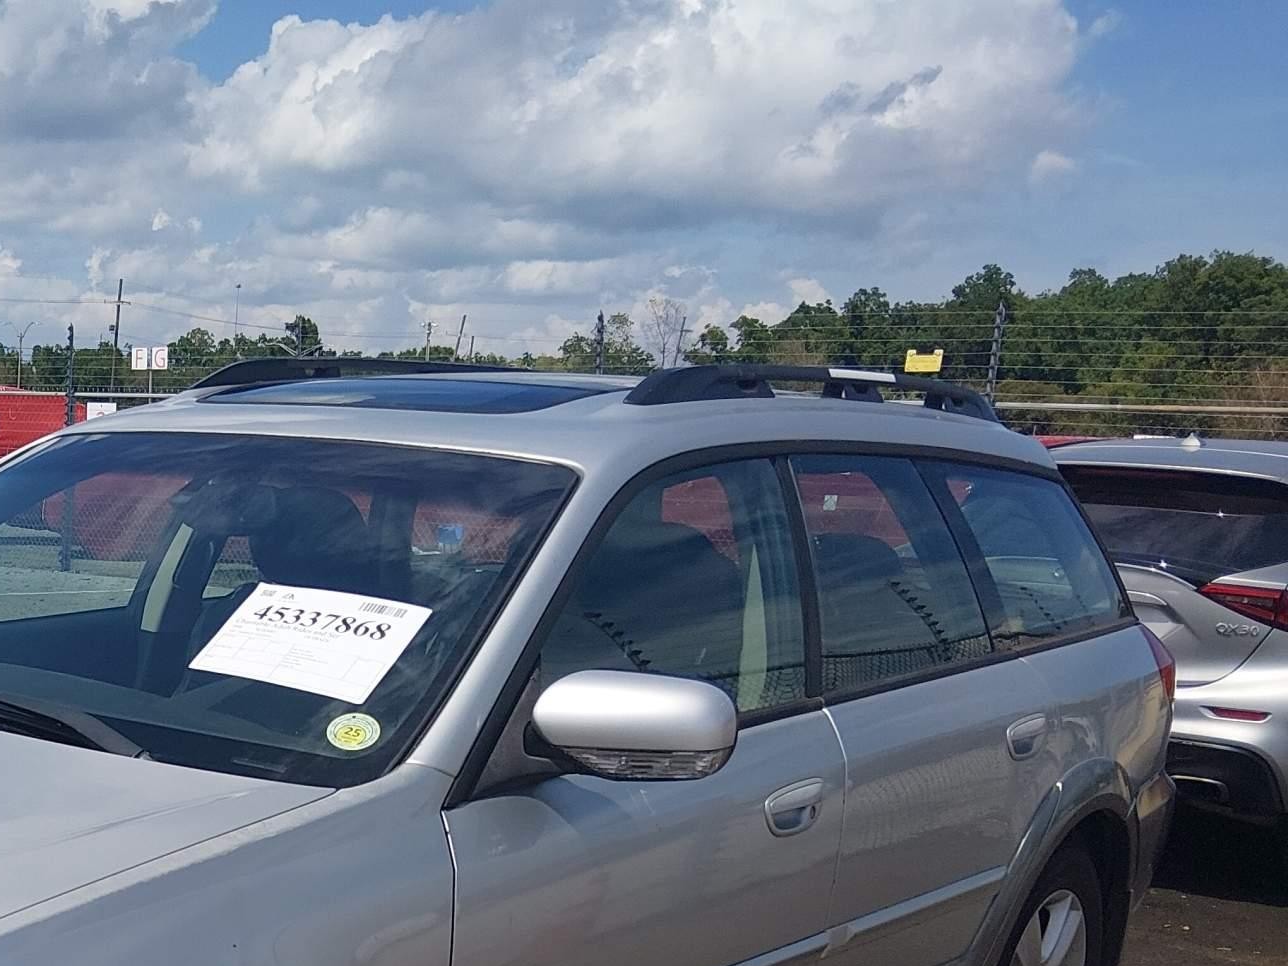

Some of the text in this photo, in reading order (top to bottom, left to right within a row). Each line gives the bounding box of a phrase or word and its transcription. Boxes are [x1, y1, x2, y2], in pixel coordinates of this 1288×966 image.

[135, 349, 166, 368] F G
[254, 605, 392, 641] 45337868
[1215, 622, 1260, 636] QX30
[344, 727, 362, 738] 25
